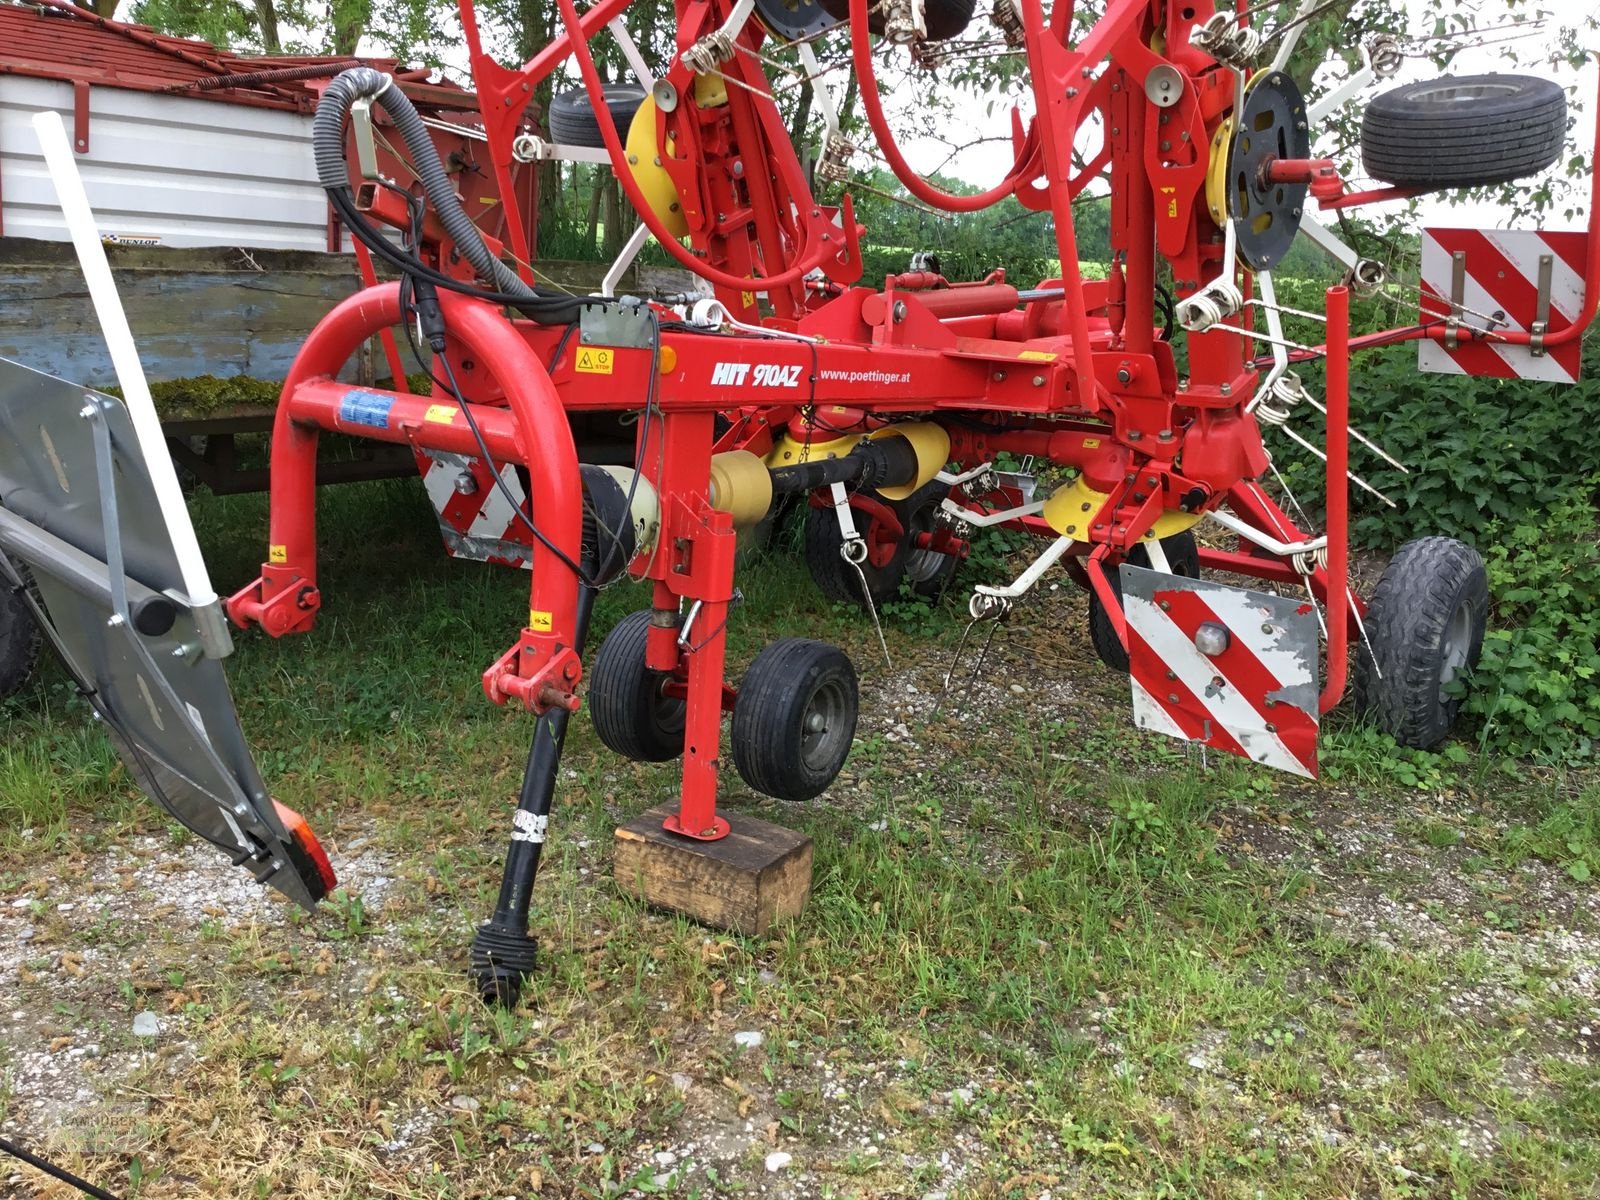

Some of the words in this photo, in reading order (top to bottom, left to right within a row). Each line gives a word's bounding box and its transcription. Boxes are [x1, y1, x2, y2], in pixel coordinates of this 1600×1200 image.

[711, 362, 751, 386] HIT
[752, 364, 803, 387] 910AZ
[820, 370, 911, 385] www.poettinger.at
